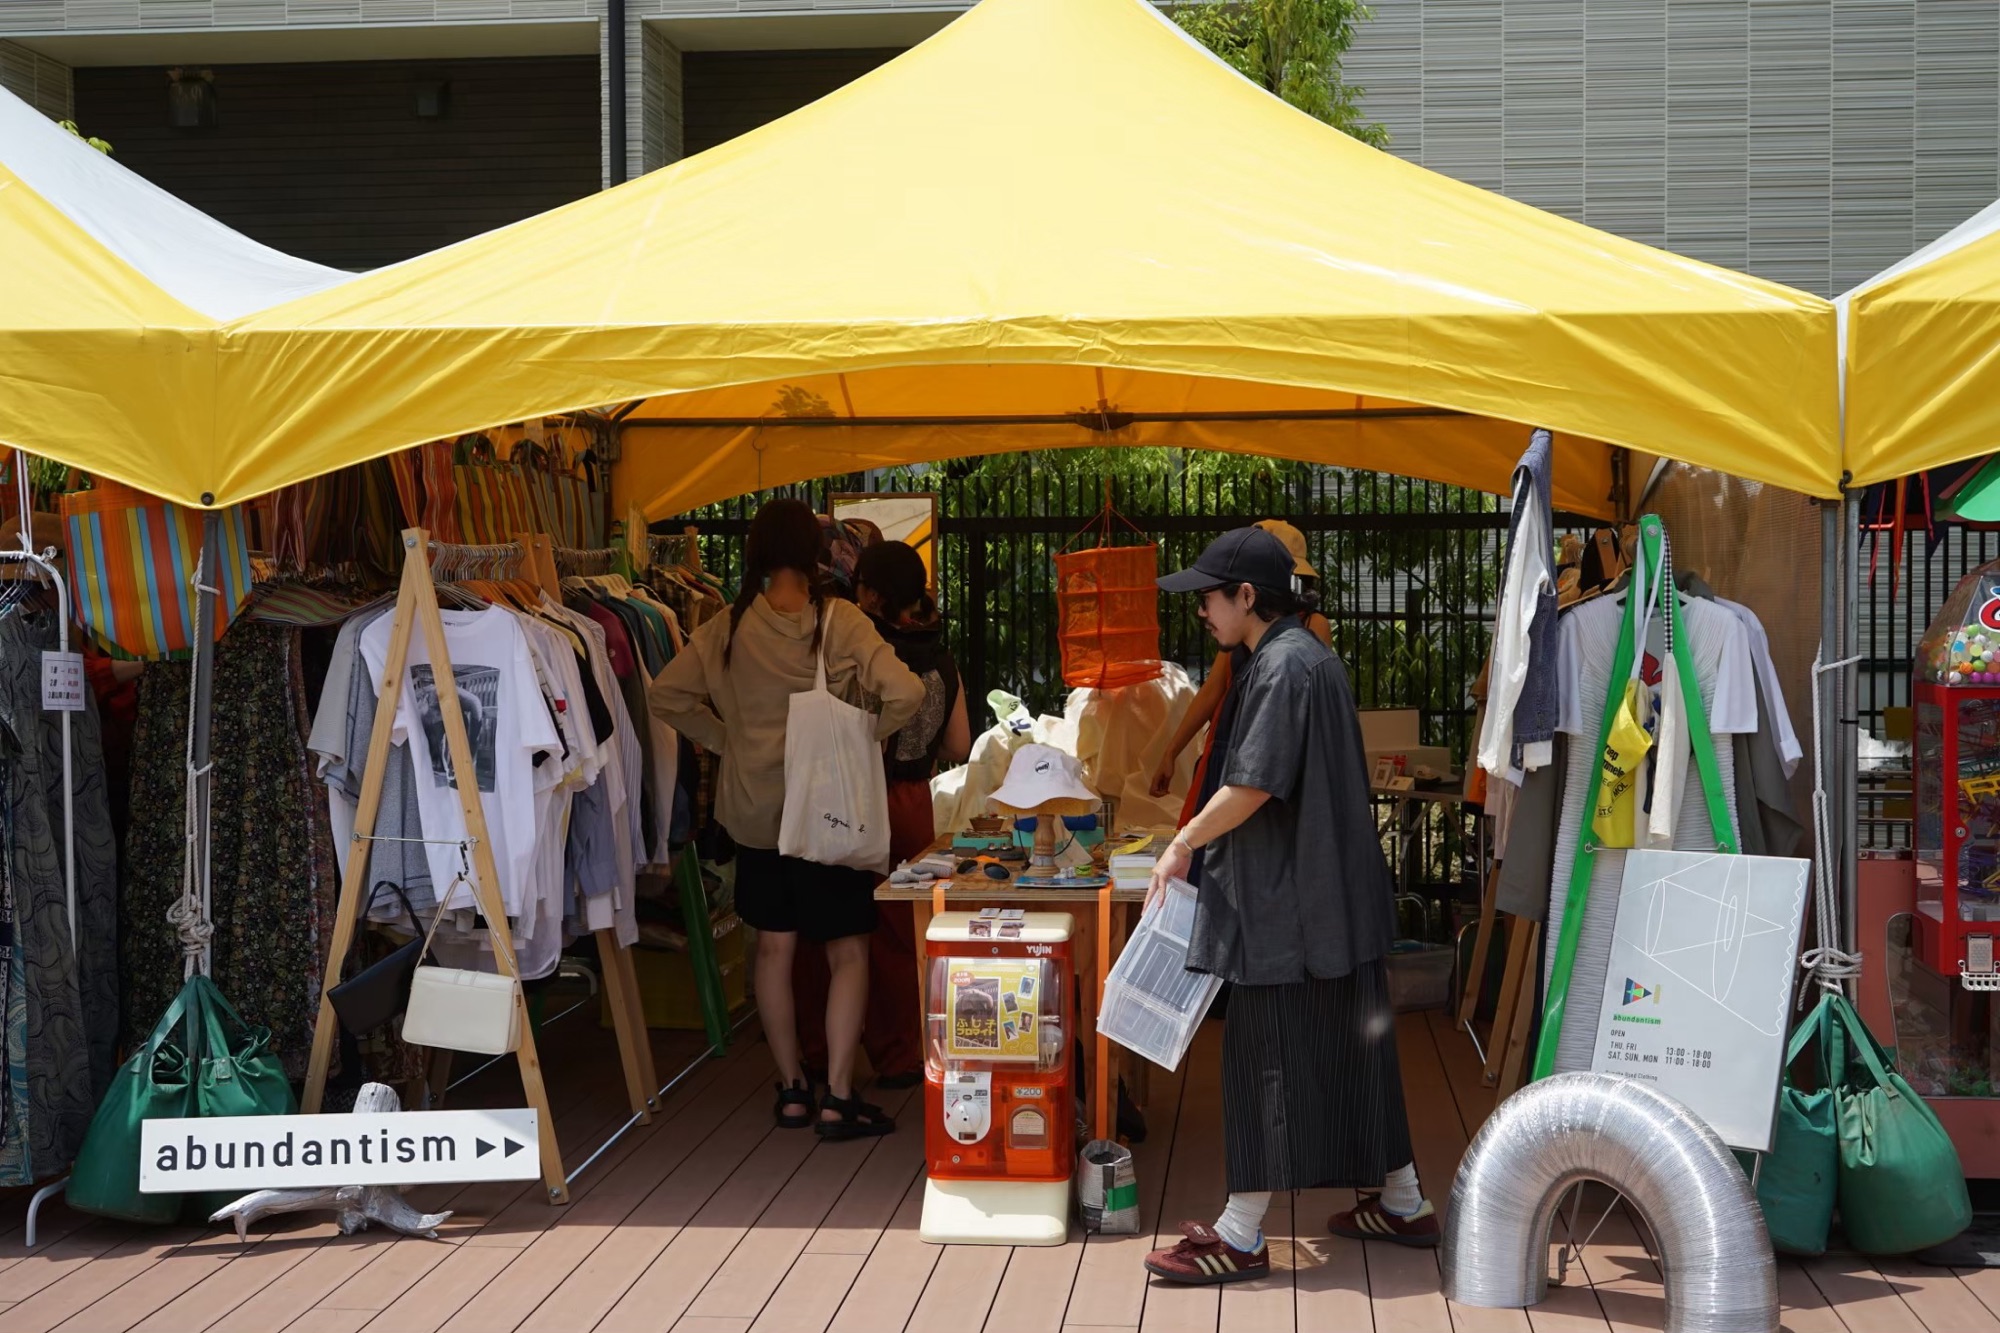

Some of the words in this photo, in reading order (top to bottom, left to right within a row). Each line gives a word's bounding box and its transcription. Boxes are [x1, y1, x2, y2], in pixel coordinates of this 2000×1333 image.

[1613, 1014, 1661, 1025] abundantism
[1610, 1029, 1626, 1037] OPEN
[1626, 1042, 1637, 1051] FRI
[1666, 1047, 1686, 1057] 13:00
[1643, 1054, 1659, 1063] MON
[1665, 1056, 1685, 1066] 11:00
[1692, 1059, 1711, 1069] 18:00
[1016, 1087, 1042, 1096] ¥200
[156, 1129, 456, 1172] abundantism
